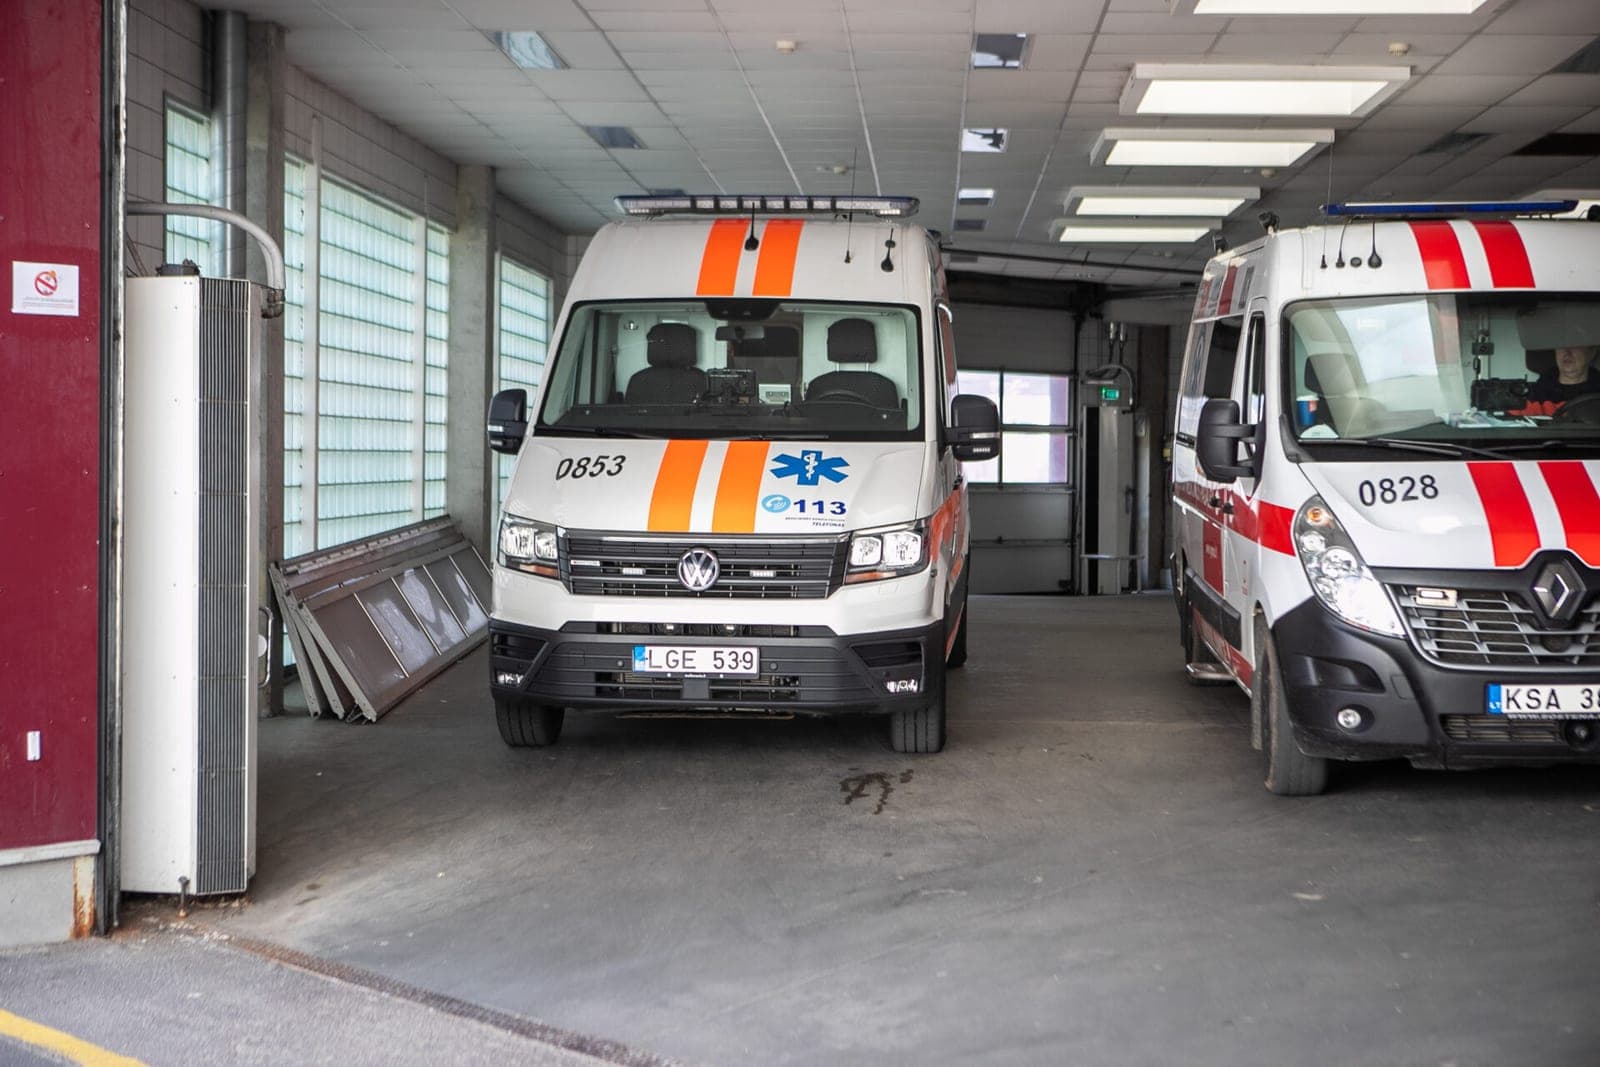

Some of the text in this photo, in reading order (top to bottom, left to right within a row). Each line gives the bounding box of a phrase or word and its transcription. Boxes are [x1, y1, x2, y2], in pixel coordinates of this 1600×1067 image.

[556, 455, 626, 480] 0853
[1359, 474, 1438, 507] 0828
[793, 499, 847, 515] 113
[648, 649, 754, 670] LGE 539
[1506, 688, 1600, 710] KSA 3
